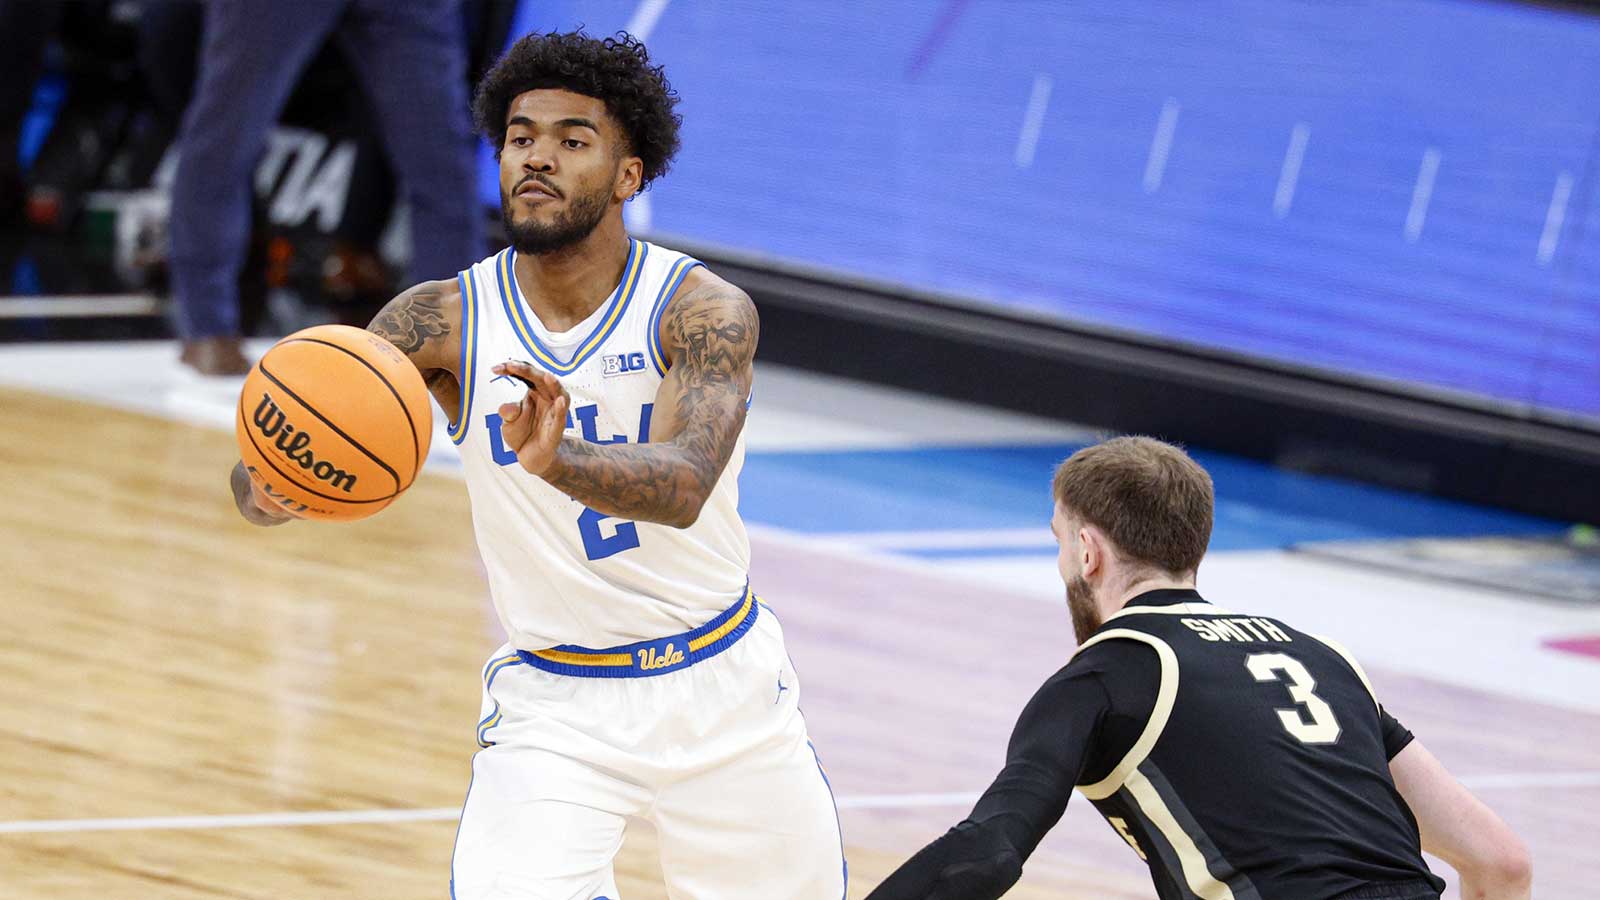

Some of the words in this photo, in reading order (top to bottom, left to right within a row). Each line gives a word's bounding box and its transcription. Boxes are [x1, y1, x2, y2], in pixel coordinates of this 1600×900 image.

[253, 392, 357, 493] Wilson
[1181, 617, 1292, 642] SMITH
[1245, 652, 1342, 744] 3
